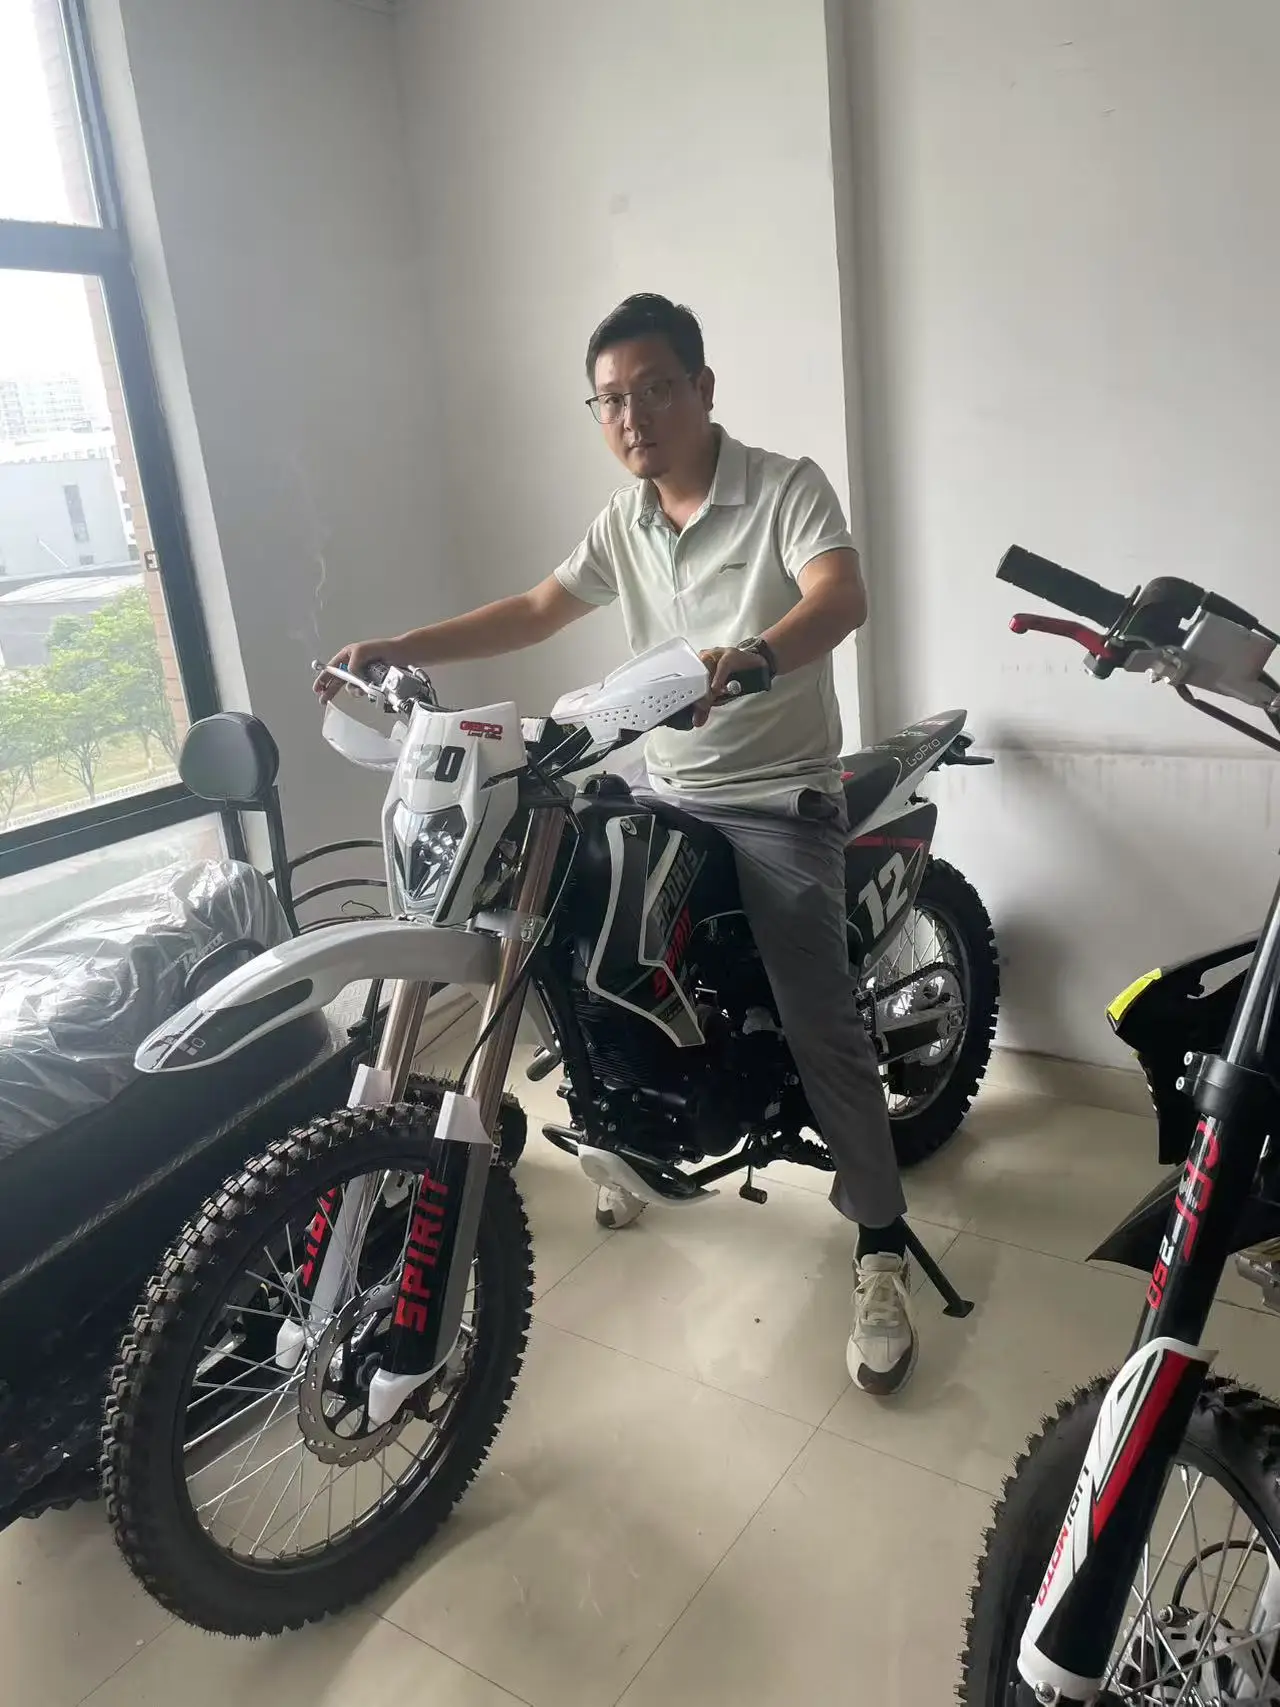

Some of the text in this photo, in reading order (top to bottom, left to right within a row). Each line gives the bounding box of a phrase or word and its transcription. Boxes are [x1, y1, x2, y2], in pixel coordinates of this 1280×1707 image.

[906, 738, 941, 767] GoPro
[394, 1168, 448, 1333] SPIRIT
[1146, 1235, 1174, 1310] 250
